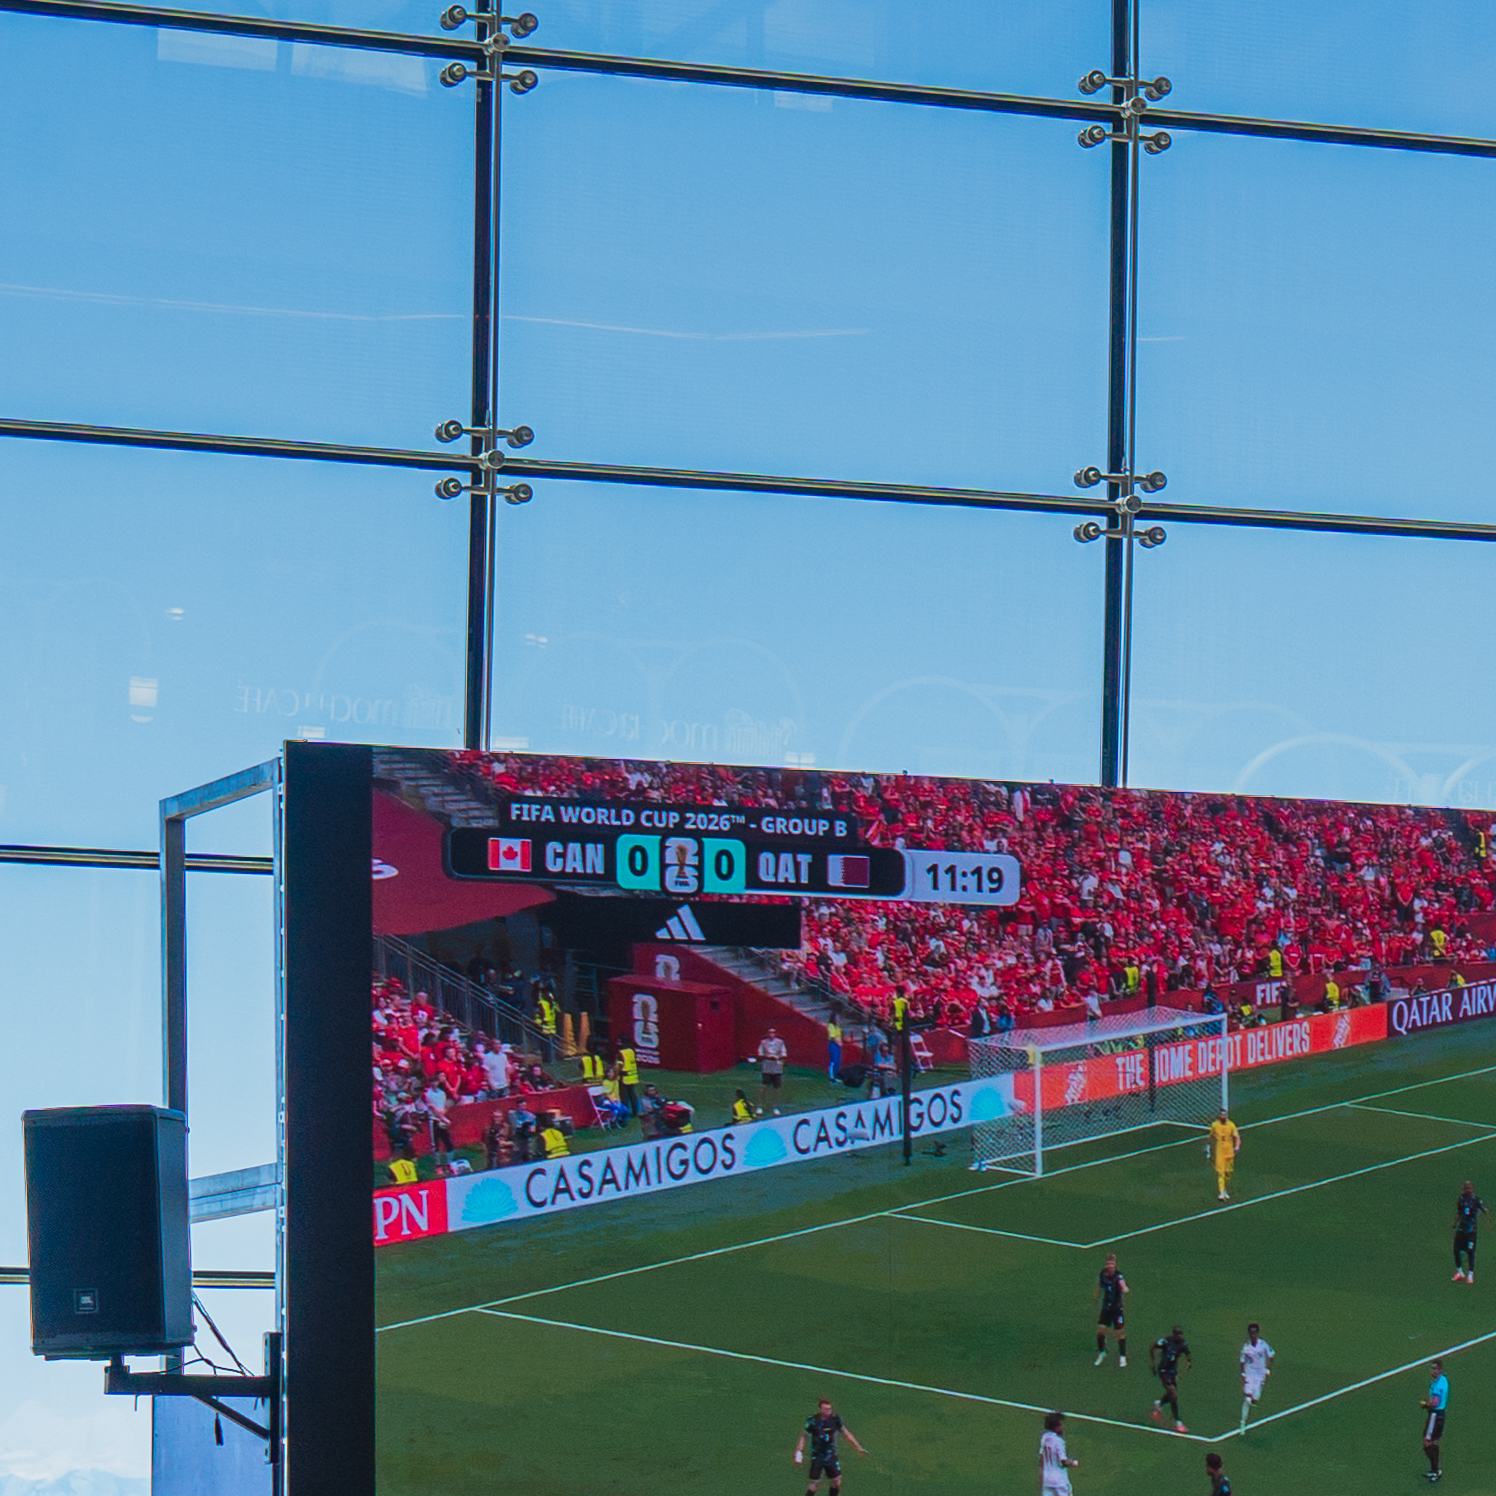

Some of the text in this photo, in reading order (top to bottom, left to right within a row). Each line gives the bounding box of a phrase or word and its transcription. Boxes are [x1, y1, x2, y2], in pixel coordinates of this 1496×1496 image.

[510, 803, 555, 822] FIFA
[560, 805, 635, 826] WORLD
[640, 810, 680, 829] CUP
[761, 816, 830, 836] GROUP
[835, 820, 848, 837] B
[545, 841, 605, 874] CAN
[628, 845, 649, 877] 0
[714, 848, 735, 882] 0
[758, 851, 812, 884] QAT
[926, 863, 1004, 894] 11:19
[1256, 982, 1287, 1006] FIF
[1392, 992, 1453, 1036] QATAR
[1116, 1053, 1145, 1091] THE
[1247, 1021, 1311, 1064] DELIVERS
[793, 1089, 963, 1155] CASAMIGOS
[525, 1132, 736, 1208] CASAMIGOS
